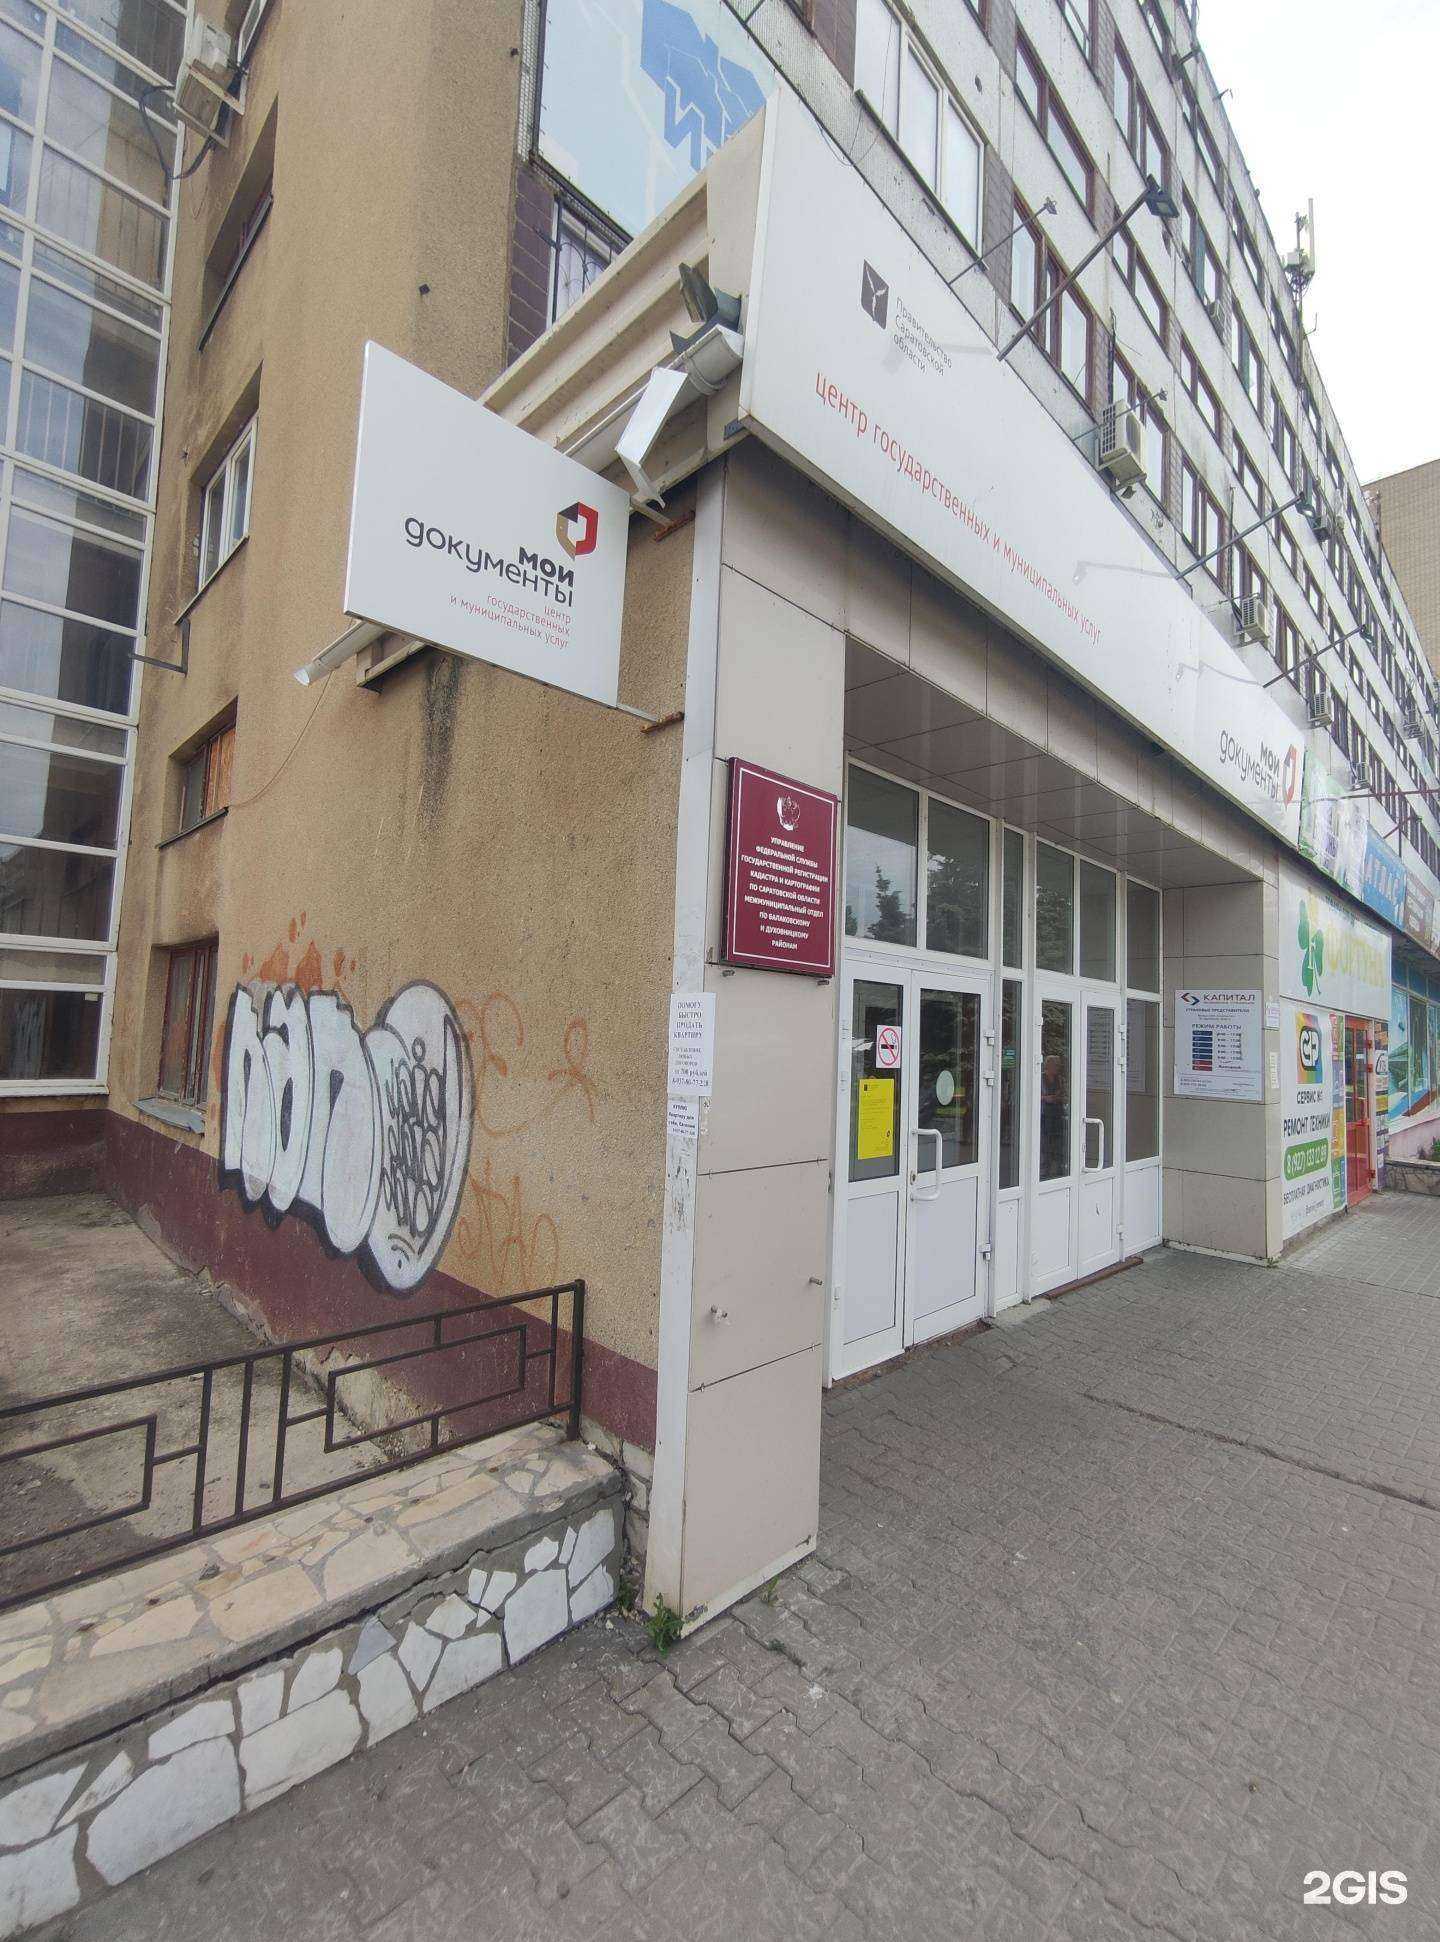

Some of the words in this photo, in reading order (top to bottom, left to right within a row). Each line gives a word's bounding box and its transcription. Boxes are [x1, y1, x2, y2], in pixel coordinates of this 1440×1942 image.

[897, 296, 952, 369] Правительство
[893, 334, 926, 373] области
[895, 314, 944, 376] Саратовской
[815, 371, 868, 437] центр
[872, 421, 989, 544] государственных
[992, 532, 1002, 552] и
[1003, 543, 1079, 622] муниципальных
[1080, 615, 1102, 647] услуг
[404, 516, 574, 607] документы
[460, 599, 542, 639] муниципальных
[545, 632, 568, 650] услуг
[487, 594, 570, 637] государственных
[544, 605, 572, 626] центр
[1219, 730, 1279, 799] документы
[770, 836, 805, 853] УПРАВЛЕНИЕ
[755, 845, 796, 863] ФЕДЕРАЛЬНОЙ
[796, 857, 818, 868] СЛУЖБЫ
[741, 854, 794, 875] ГОСУДАРСТВЕННОЙ
[794, 868, 829, 883] РЕГИСТРАЦИИ
[750, 870, 779, 883] КАДАСТРА
[784, 878, 820, 893] КАРТОГРАФИИ
[744, 894, 807, 915] МЕЖМУНИЦИПАЛЬНЫЙ
[749, 883, 758, 891] ПО
[758, 884, 797, 900] САРАТОВСКОЙ
[797, 894, 820, 905] ОБЛАСТИ
[759, 911, 768, 920] ПО
[768, 912, 810, 927] БАЛАКОВСКОМУ
[765, 926, 809, 940] ДУХОВНИЦКОМУ
[771, 939, 798, 950] РАЙОНАМ
[676, 1021, 703, 1029] ПРОДАТЬ
[1296, 1090, 1316, 1104] СЕРВИС
[1284, 1117, 1309, 1138] РЕМОНТ
[1310, 1112, 1331, 1132] ТЕХНИКИ
